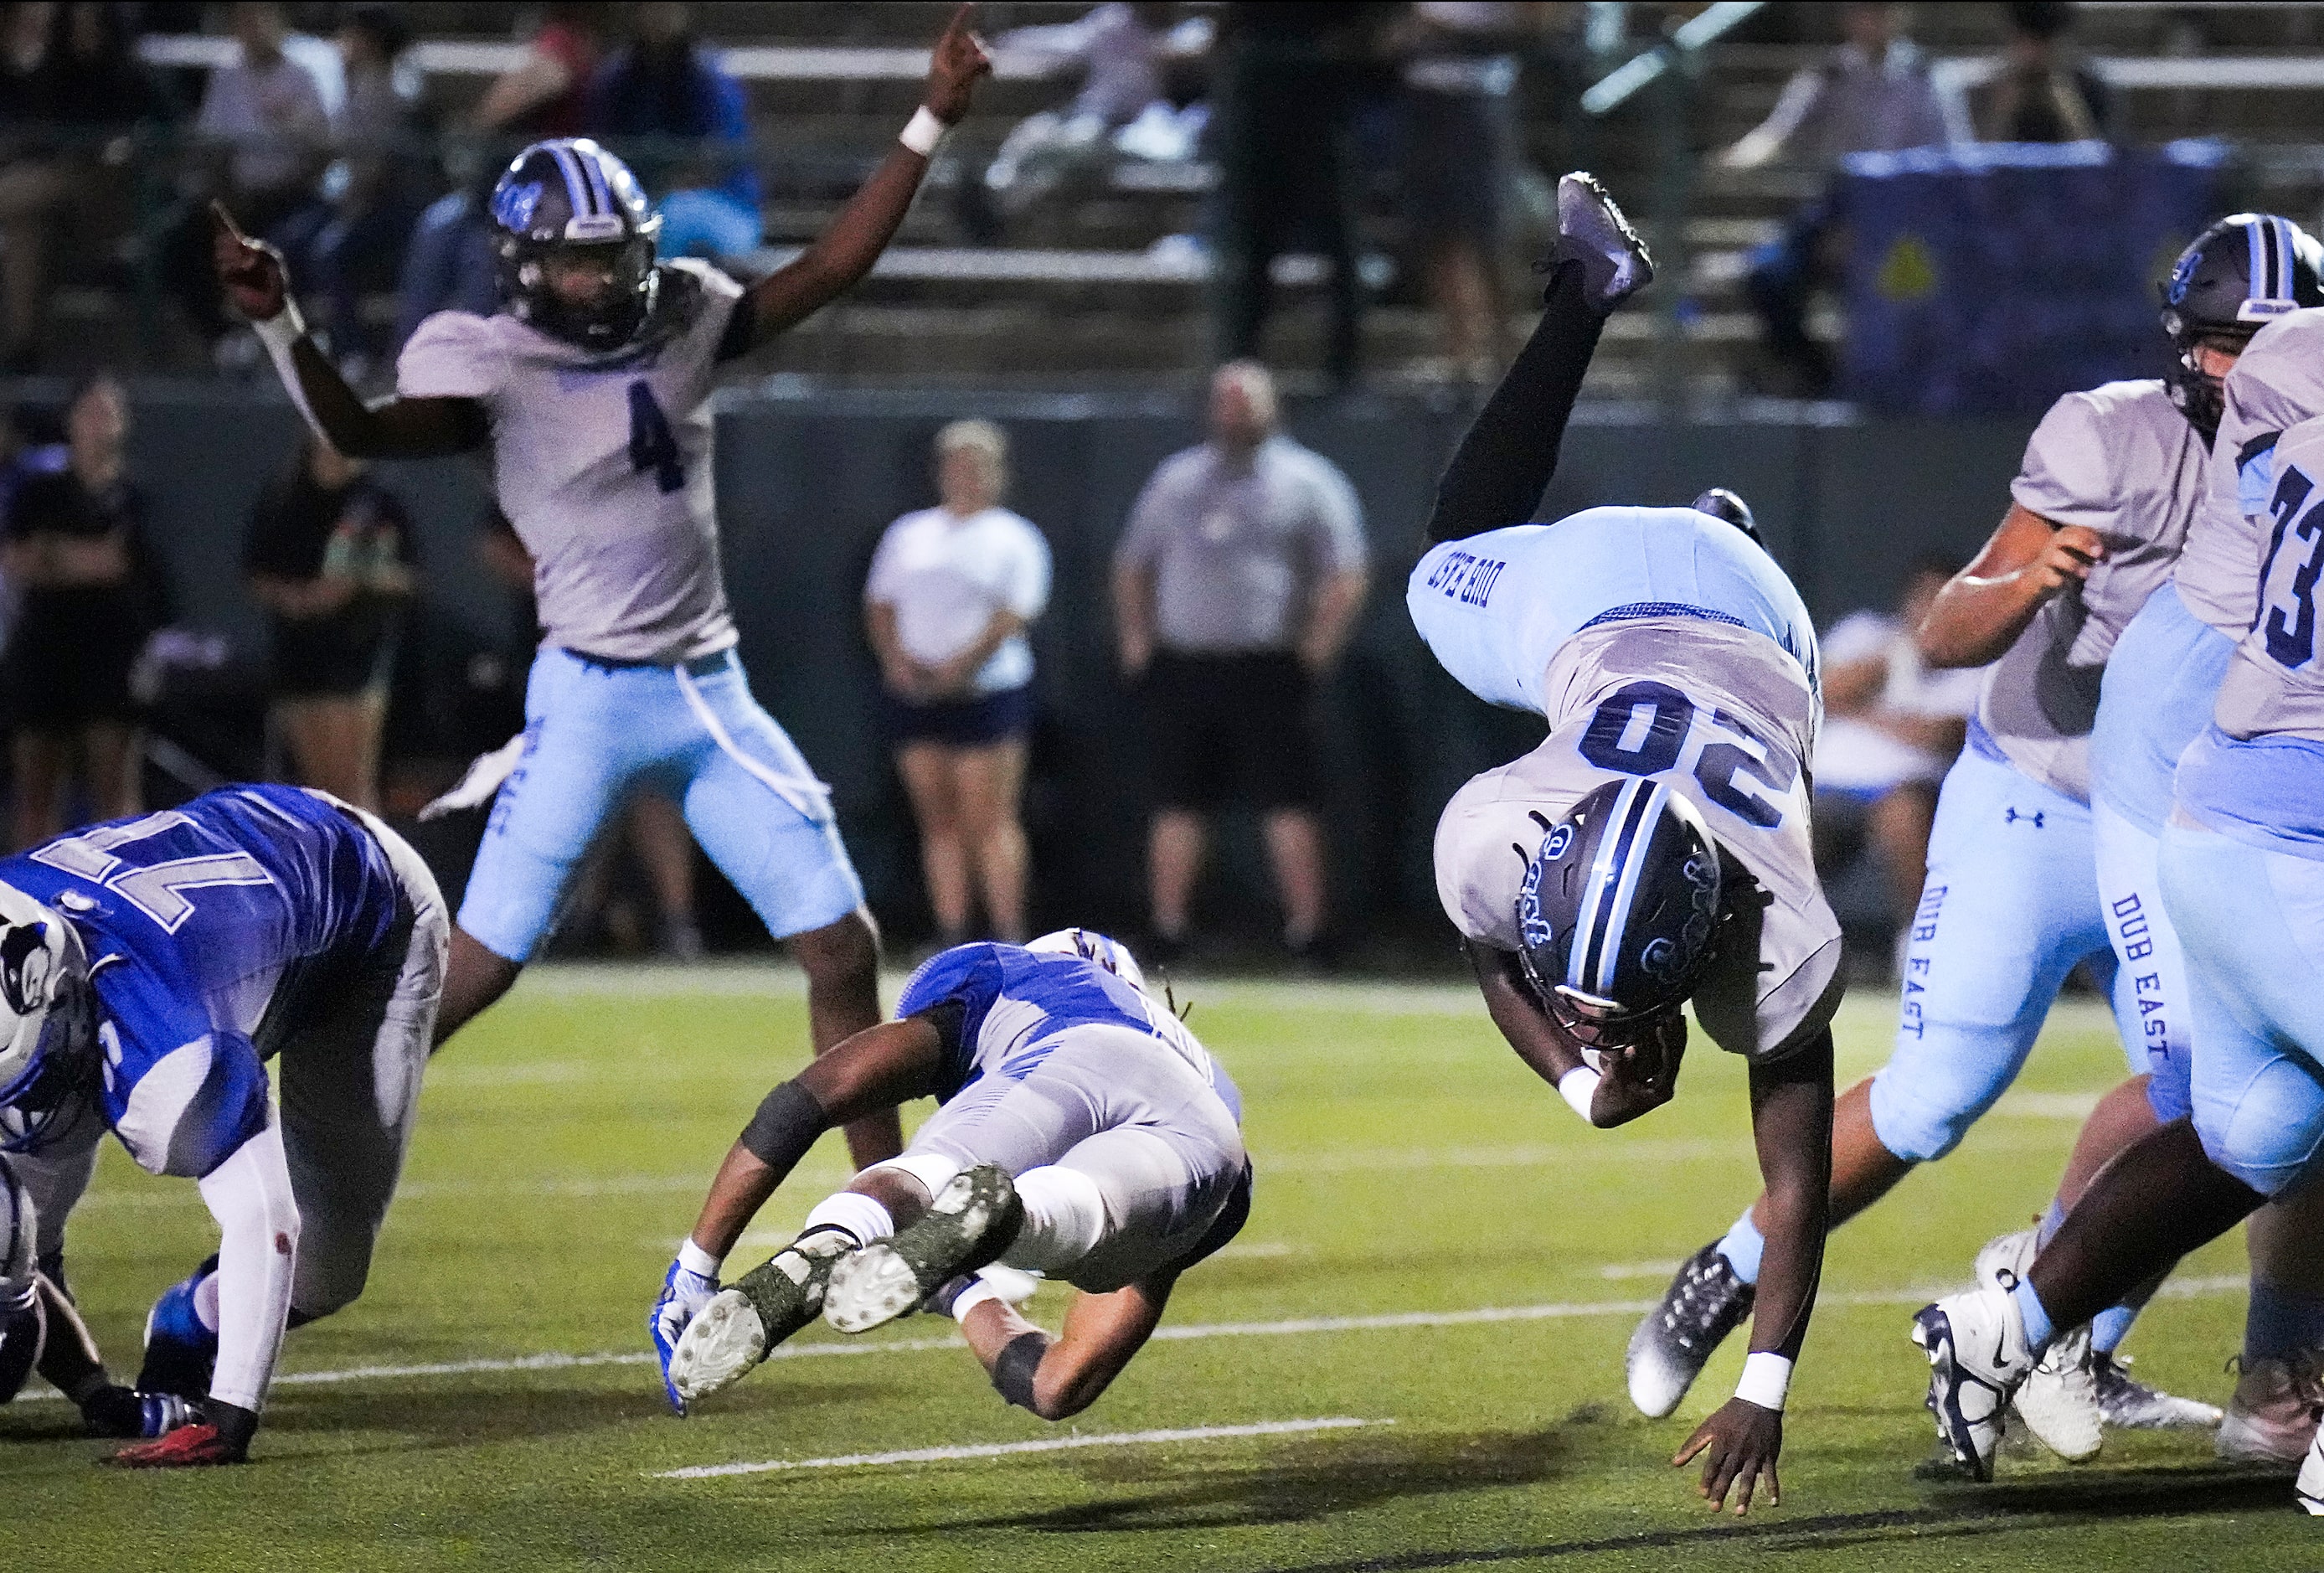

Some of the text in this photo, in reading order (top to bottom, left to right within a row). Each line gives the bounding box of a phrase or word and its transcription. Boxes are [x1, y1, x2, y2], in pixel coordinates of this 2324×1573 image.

[628, 379, 685, 493] 4
[1427, 551, 1507, 608] DUB EAST
[2249, 464, 2324, 669] 73
[1578, 680, 1798, 829] 20
[1902, 885, 1949, 1040] DUB EAST
[2112, 892, 2170, 1061] DUB EAST
